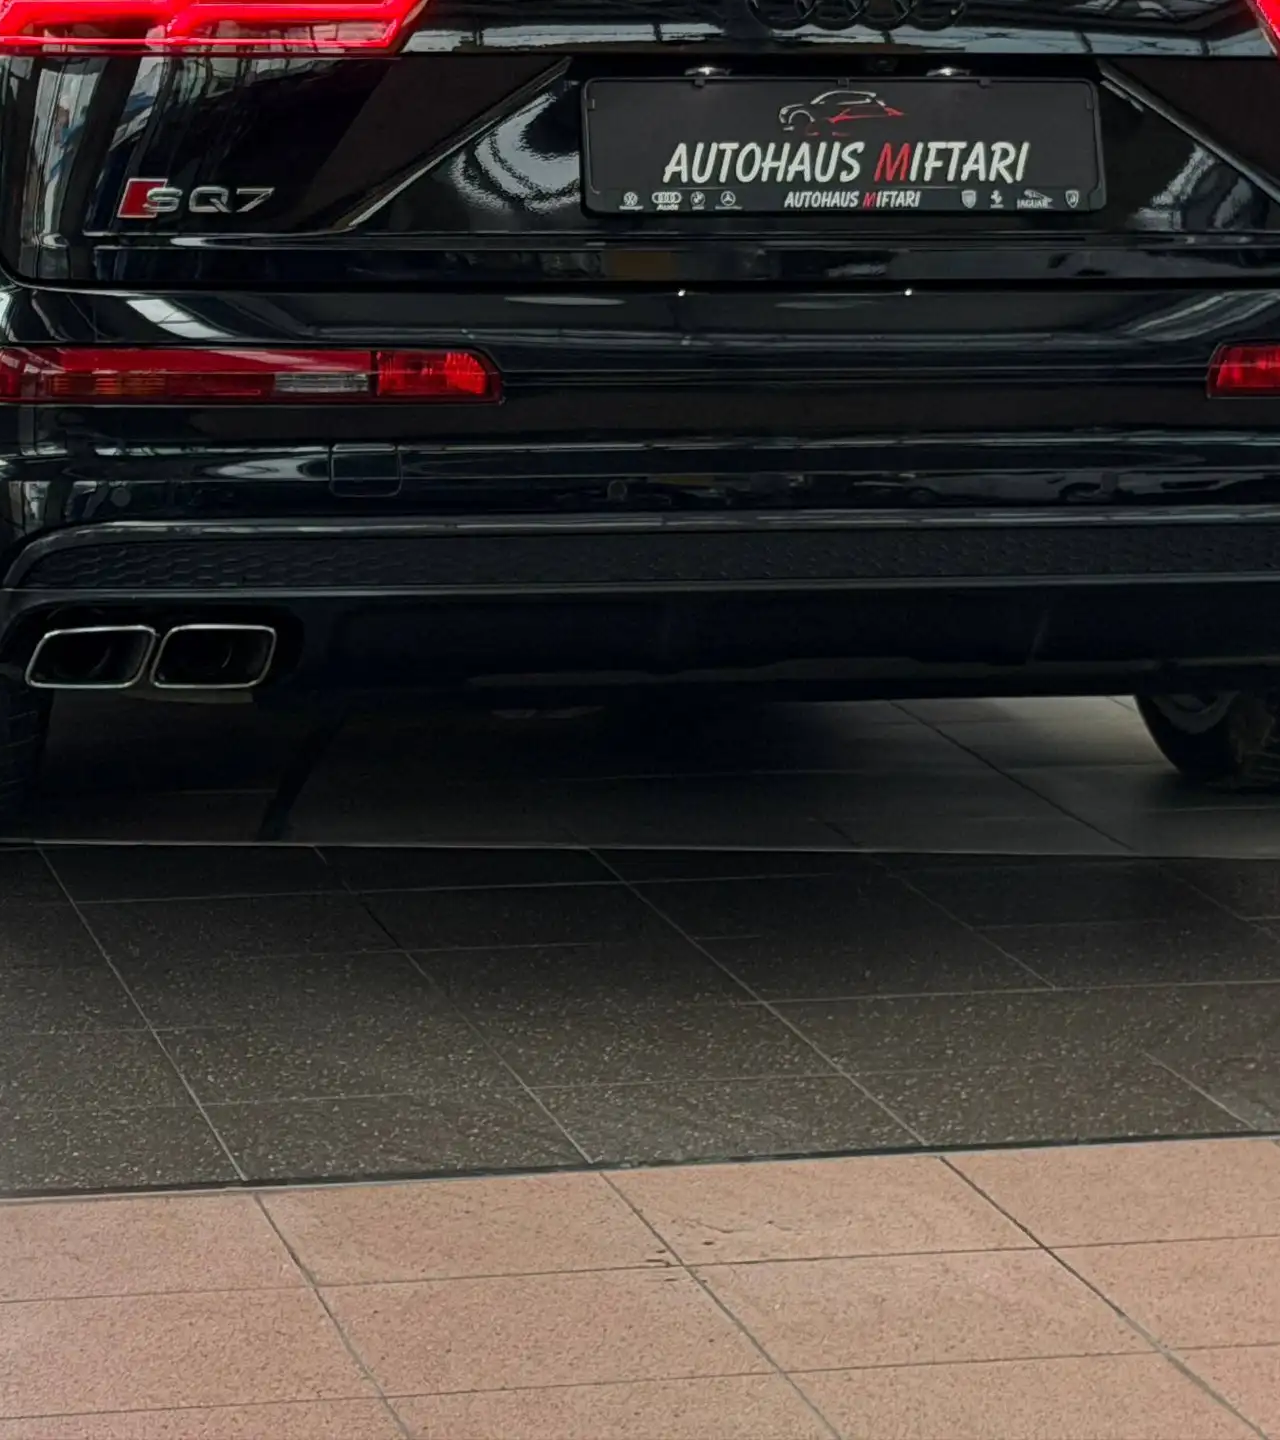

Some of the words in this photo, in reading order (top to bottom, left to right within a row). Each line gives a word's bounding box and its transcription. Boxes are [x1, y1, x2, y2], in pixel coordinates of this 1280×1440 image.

[662, 141, 866, 184] AUTOHAUS
[873, 141, 1030, 184] MIFTARI
[142, 186, 276, 213] SQ7
[784, 190, 861, 209] AUTOHAUS
[862, 190, 922, 209] MIFTARI
[1016, 198, 1050, 210] JAGUAR
